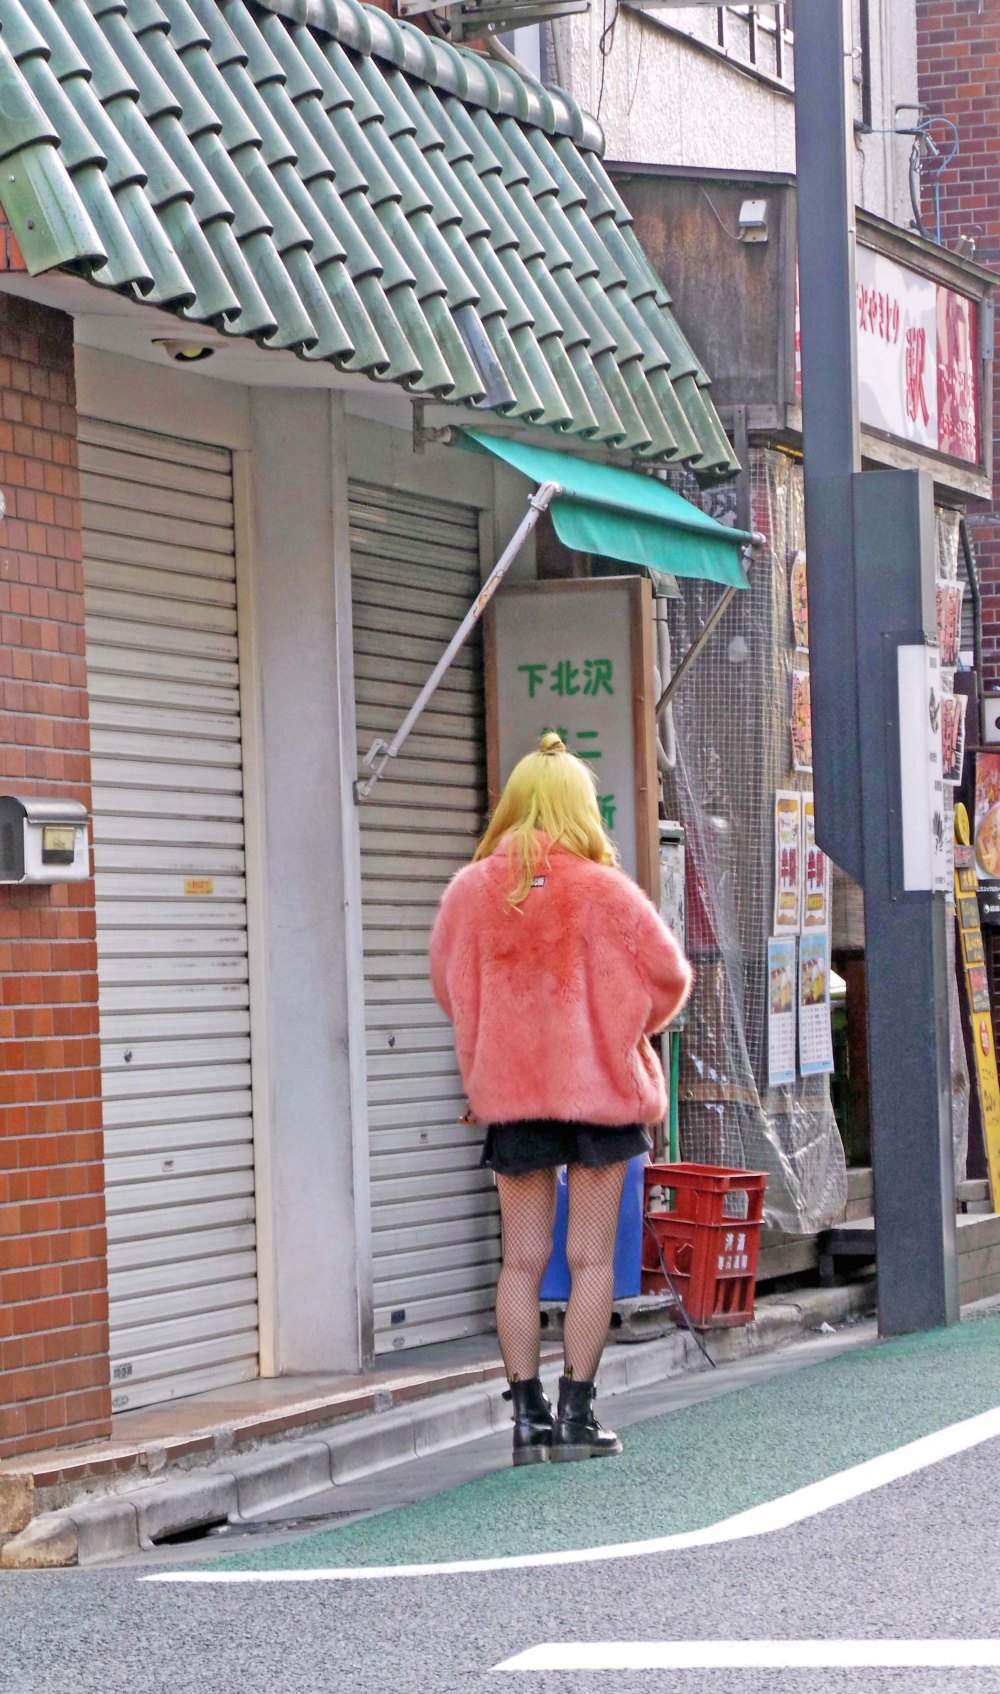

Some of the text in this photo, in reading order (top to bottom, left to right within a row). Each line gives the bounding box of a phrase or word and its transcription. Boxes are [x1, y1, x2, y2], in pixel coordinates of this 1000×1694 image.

[857, 284, 899, 345] 火やきとり
[518, 660, 615, 697] 下北沢
[542, 726, 602, 759] 二
